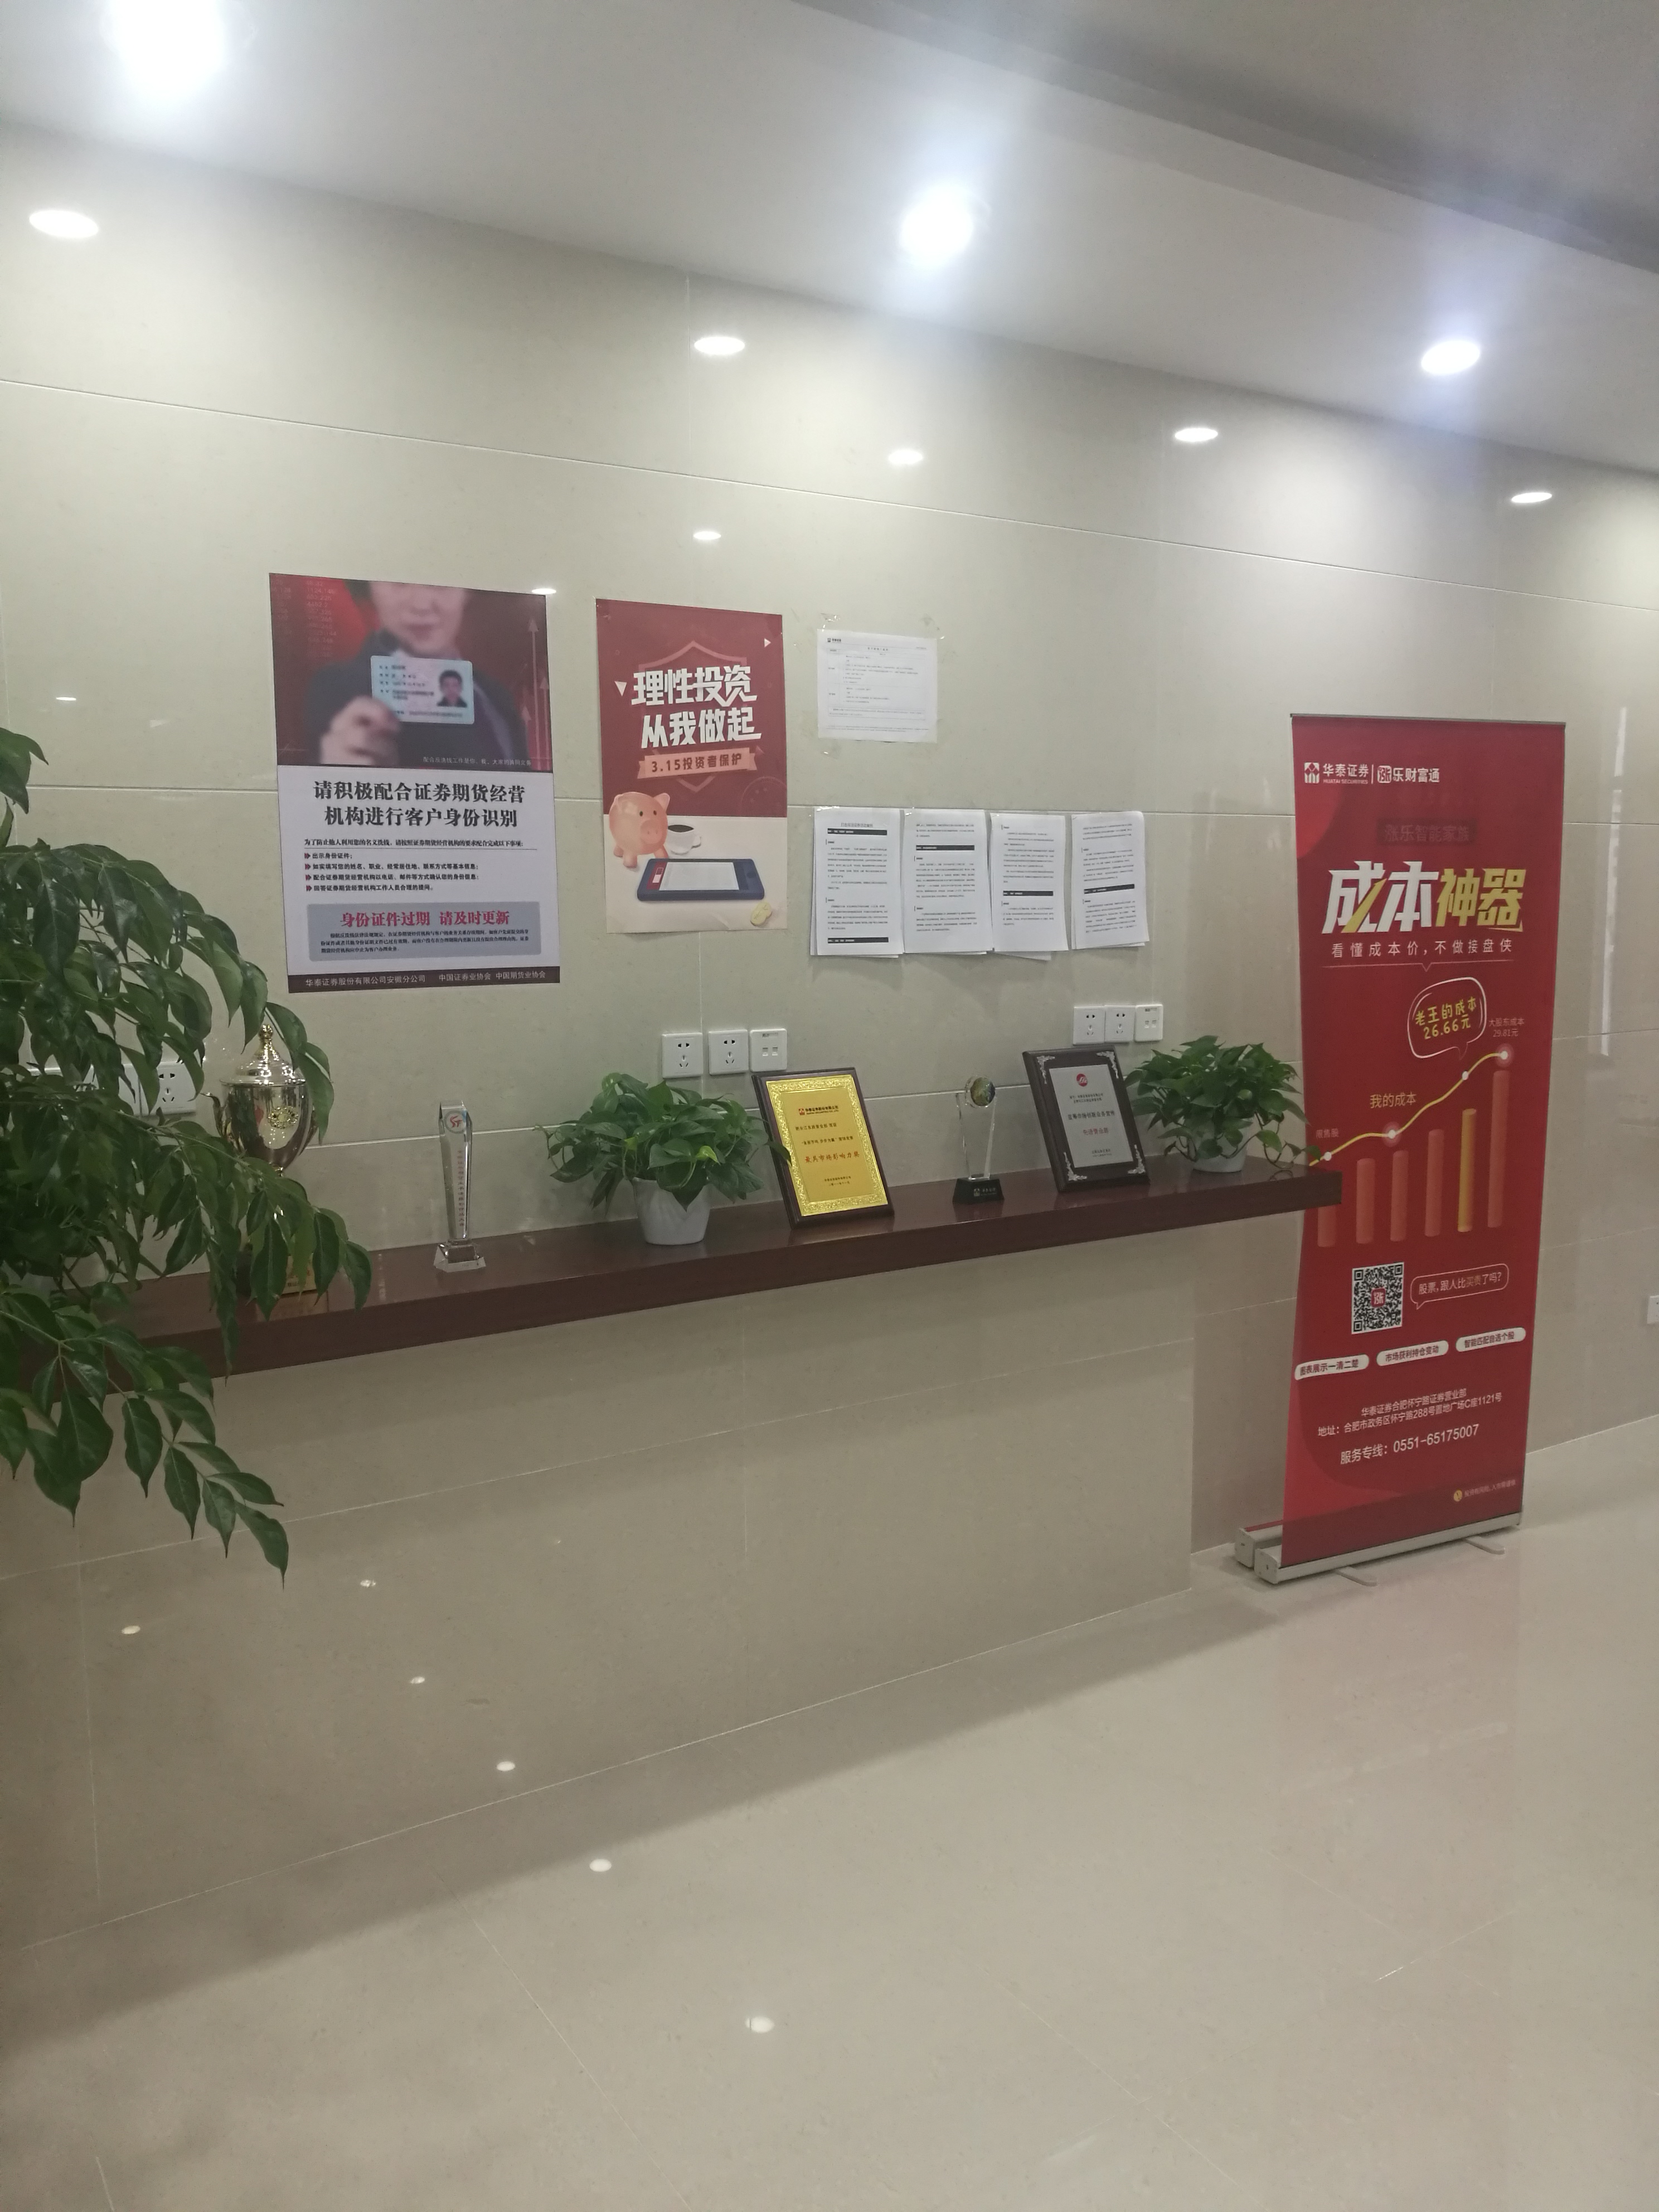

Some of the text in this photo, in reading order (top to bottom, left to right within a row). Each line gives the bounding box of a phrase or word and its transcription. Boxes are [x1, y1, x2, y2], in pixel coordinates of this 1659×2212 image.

[630, 664, 758, 707] 理性投资
[641, 707, 762, 749] 从我做起
[651, 753, 743, 773] 3.15投资者保护
[1322, 763, 1369, 778] 华泰证券
[313, 780, 525, 803] 请积极配合证券期货经营
[324, 806, 518, 827] 机构进行客户身份识别
[1321, 860, 1527, 934] 成本神器
[339, 910, 510, 928] 身份证件过期 请及时更新
[1331, 938, 1512, 958] 看懂成本价，不做接盘侠
[305, 970, 546, 987] 华泰证券股份有限公司安徽分公司 中国证券业协会 中国期货业协会
[1415, 996, 1477, 1026] 老王的成本
[1423, 1014, 1471, 1040] 26.66元
[1488, 1017, 1525, 1027] 大股东成本
[1492, 1028, 1519, 1037] 29.81元
[1369, 1091, 1417, 1109] 我的成本
[1374, 1291, 1385, 1306] 涨
[1299, 1331, 1515, 1376] 图表展示一清二楚 市场获利持仓变动 智能匹配自选个股
[1361, 1388, 1467, 1417] 华泰证券合肥怀宁路证券营业部
[1340, 1423, 1479, 1465] 服务专线：0551-65175007
